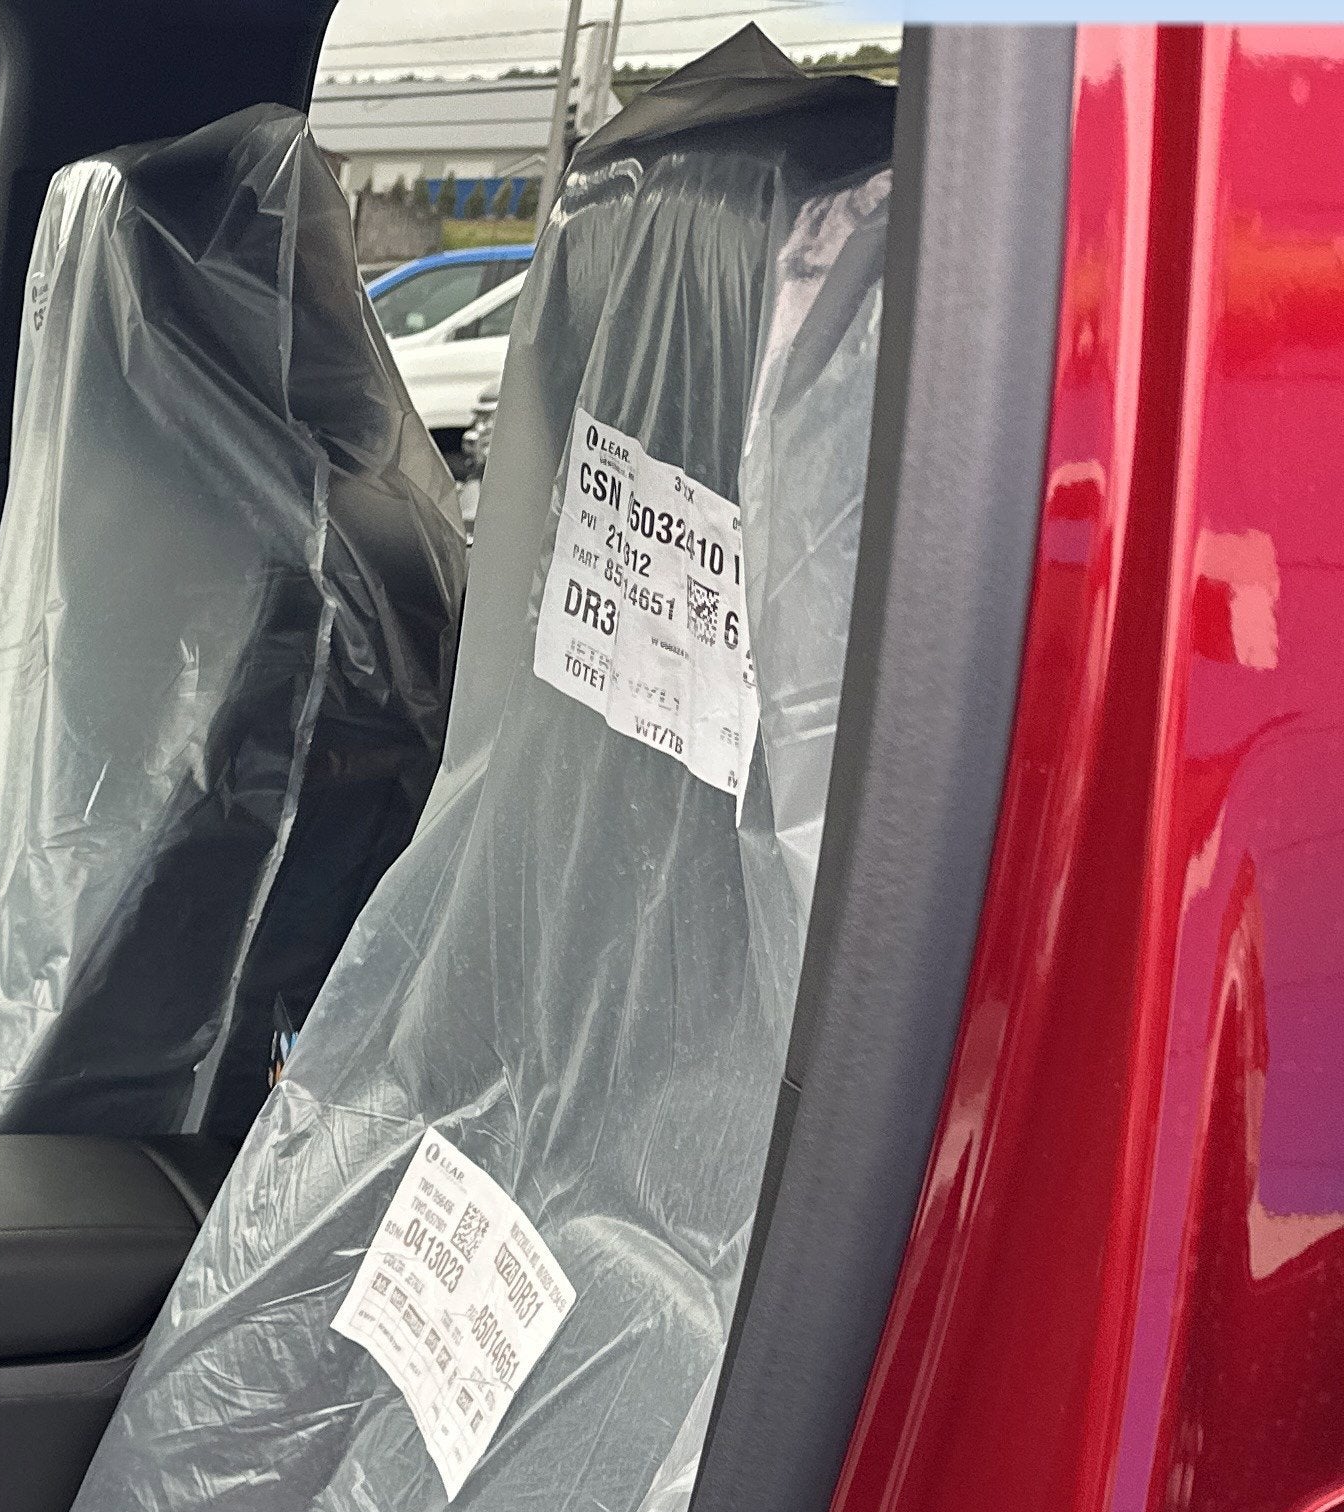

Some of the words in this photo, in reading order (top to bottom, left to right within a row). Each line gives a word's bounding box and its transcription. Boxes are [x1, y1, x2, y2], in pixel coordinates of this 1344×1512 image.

[600, 437, 629, 463] LEAR
[578, 461, 622, 511] CSN
[580, 510, 596, 530] PVI
[572, 544, 600, 571] PART
[564, 578, 620, 644] DR3
[724, 607, 738, 654] 6
[439, 1155, 465, 1183] LEAR
[401, 1215, 465, 1296] 0413023
[507, 1270, 544, 1330] DR31
[469, 1302, 521, 1387] 85014651
